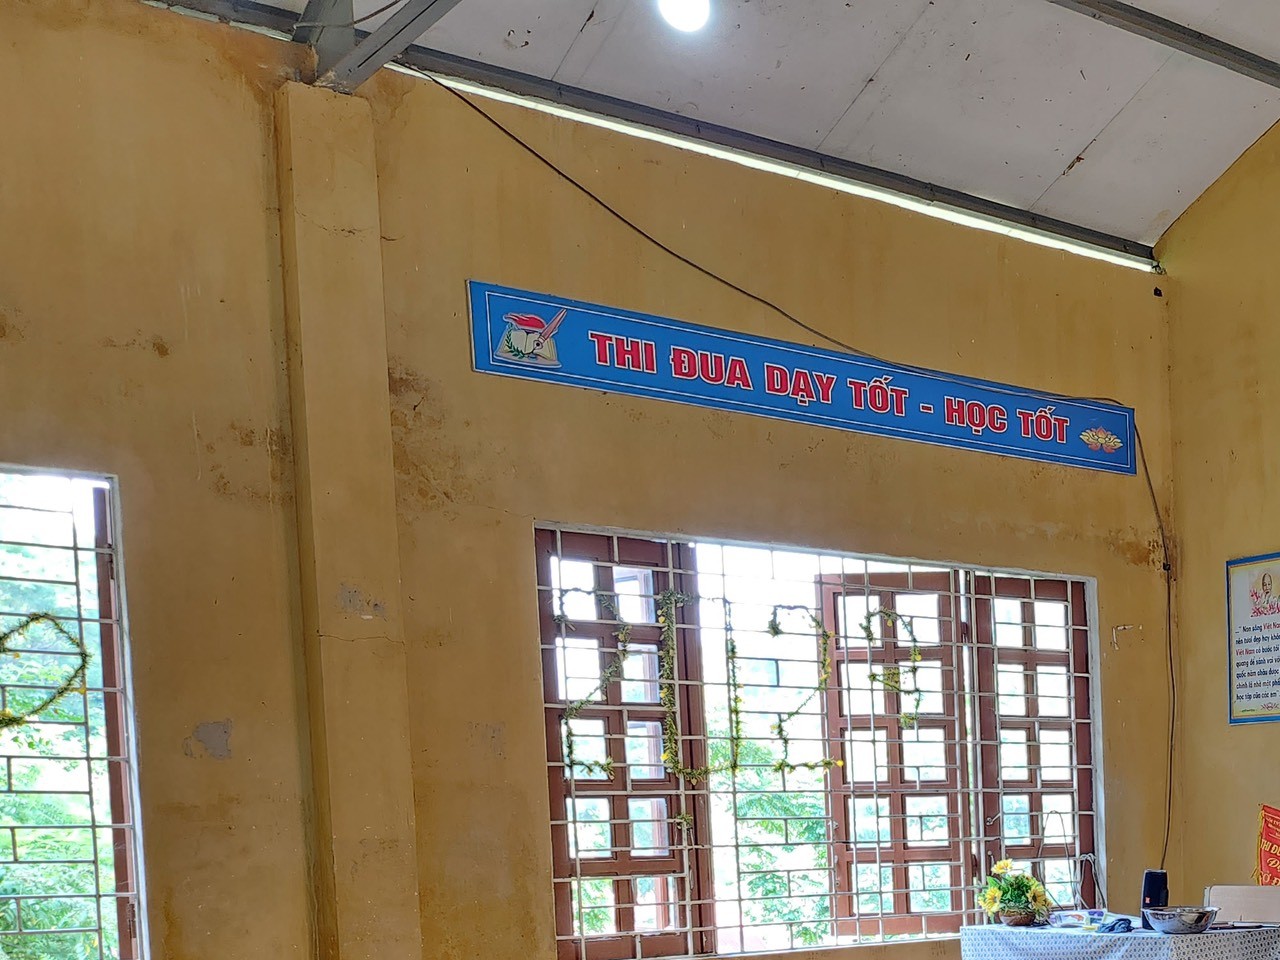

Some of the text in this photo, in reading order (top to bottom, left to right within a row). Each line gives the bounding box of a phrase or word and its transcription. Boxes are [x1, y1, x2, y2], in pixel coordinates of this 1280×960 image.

[588, 331, 656, 374] THI
[671, 346, 753, 391] ĐUA
[765, 363, 837, 407] DẠY
[847, 376, 908, 418] TỐT
[945, 396, 1007, 436] HỌC
[1016, 406, 1069, 445] TỐT
